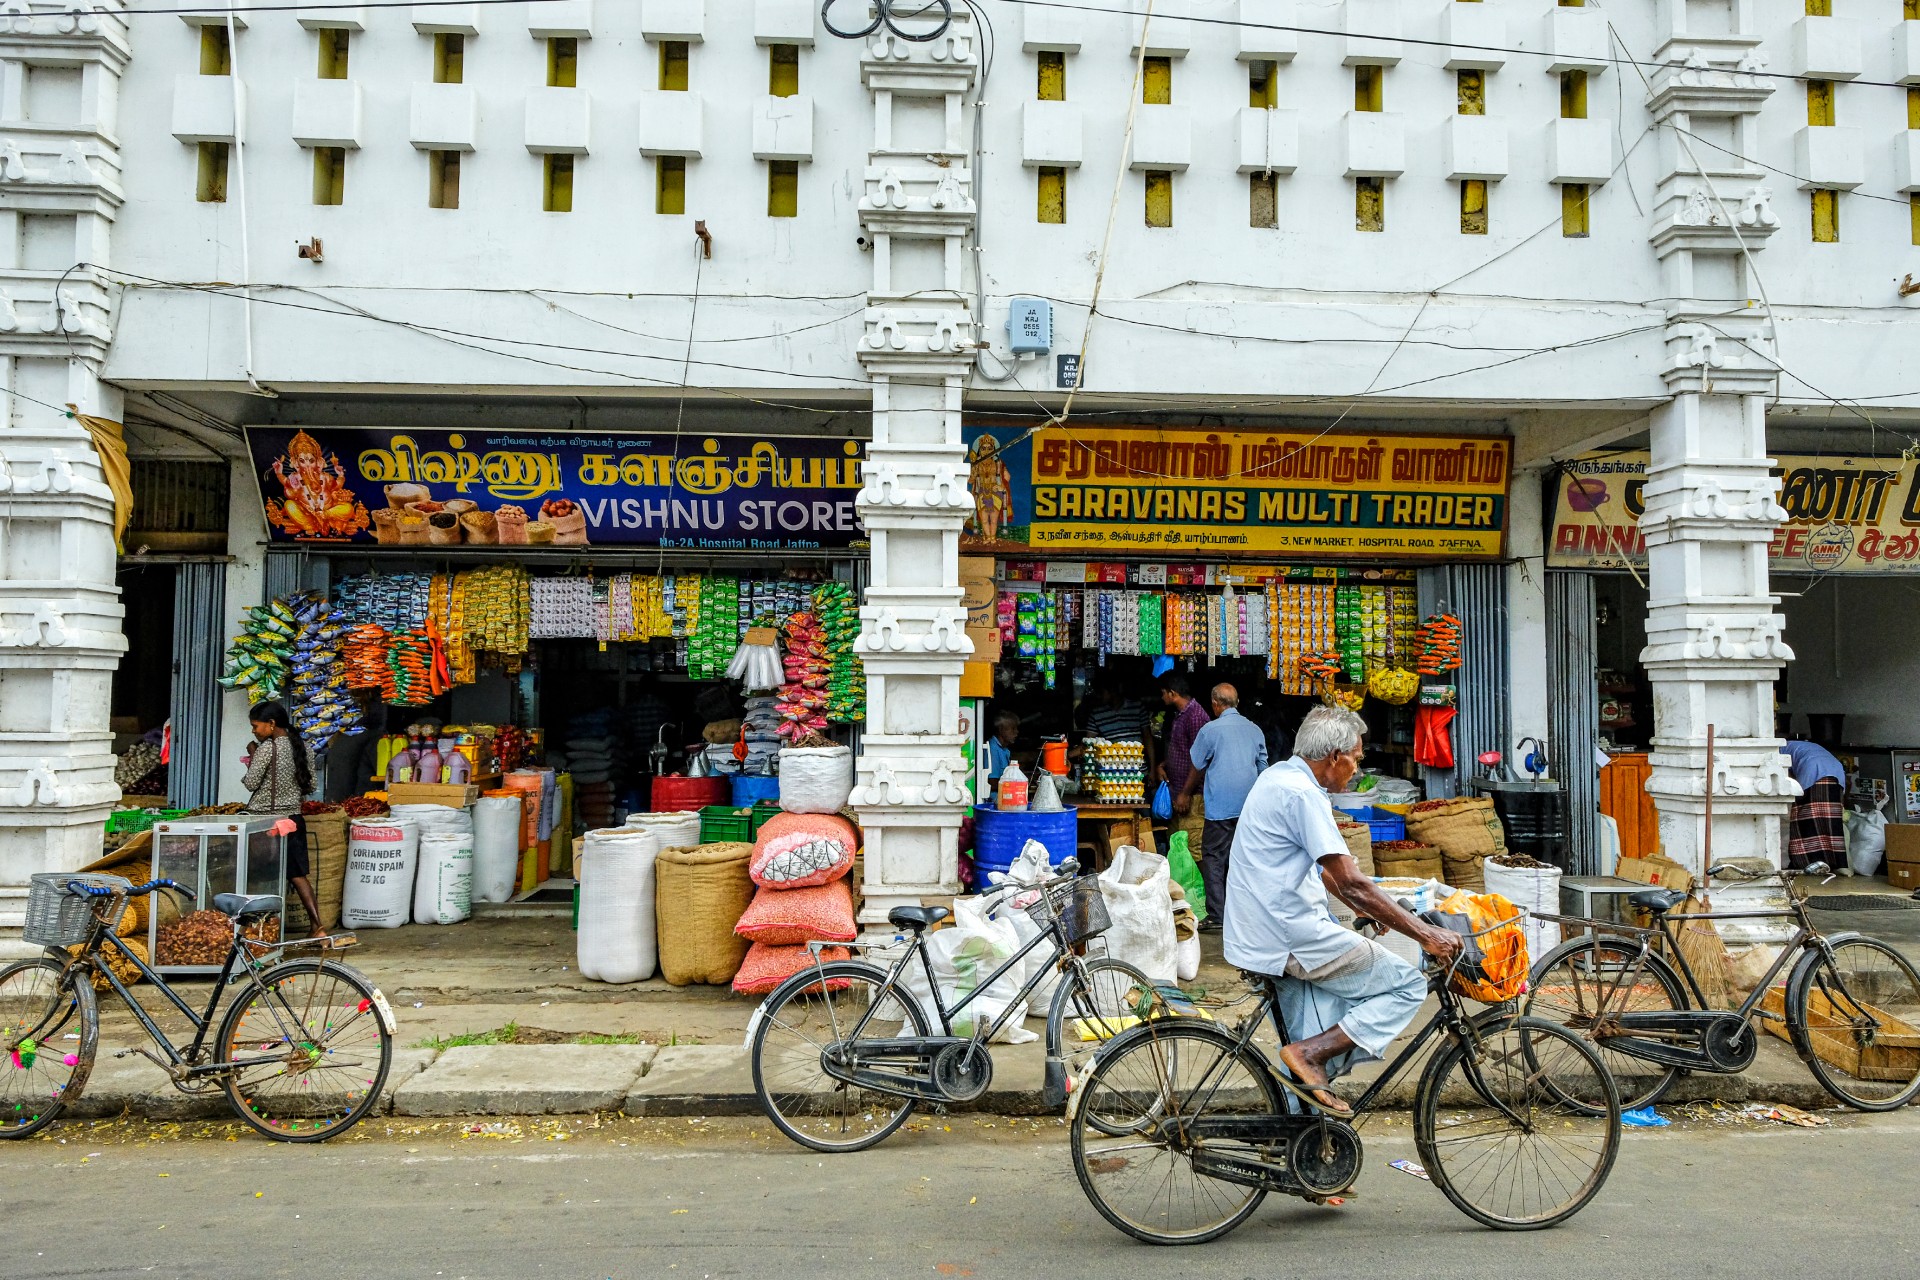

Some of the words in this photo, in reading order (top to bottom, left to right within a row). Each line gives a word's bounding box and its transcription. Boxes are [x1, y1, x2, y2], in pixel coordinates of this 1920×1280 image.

[1038, 434, 1232, 480] சரவணாஸ்
[1241, 437, 1386, 485] பல்பொருள்
[1392, 442, 1505, 484] வாணிபம்
[358, 433, 563, 500] விஷ்ணு
[579, 438, 864, 494] களஞ்சியம்
[1035, 487, 1248, 521] SARAVANAS
[1259, 491, 1361, 524] MULTI
[1371, 494, 1494, 527] TRADER
[579, 497, 724, 530] VISHNU
[1292, 537, 1312, 545] NEW
[1358, 538, 1406, 546] HOSPITAL
[1813, 545, 1841, 554] ANNA
[353, 848, 402, 858] CORIANDER
[350, 861, 376, 871] ORIGEN
[378, 861, 404, 871] SPAIN
[360, 874, 371, 883] 25
[373, 876, 386, 884] KG
